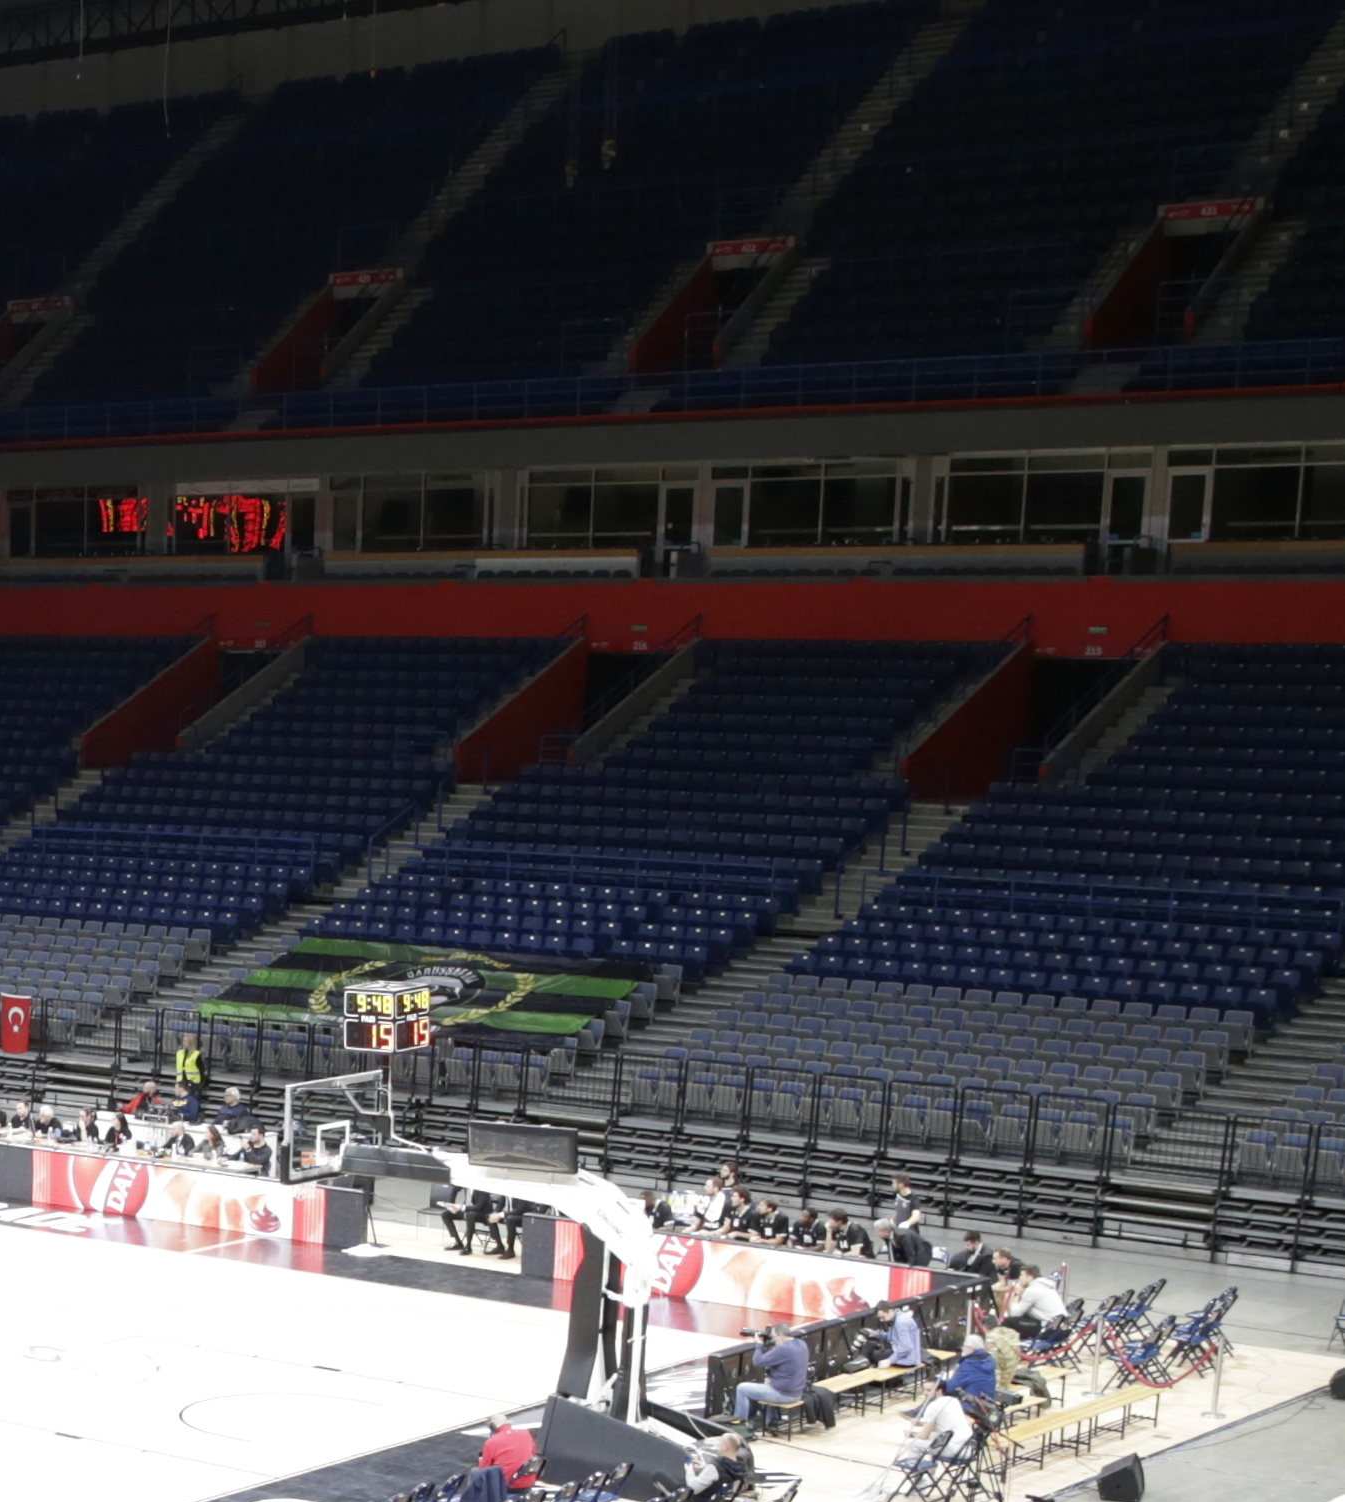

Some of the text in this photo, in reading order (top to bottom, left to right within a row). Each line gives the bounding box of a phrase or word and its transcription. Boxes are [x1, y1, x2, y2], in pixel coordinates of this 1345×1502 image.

[356, 994, 393, 1014] 9:48
[403, 991, 430, 1012] 9:48
[371, 1024, 393, 1049] 15
[413, 1020, 429, 1045] 15
